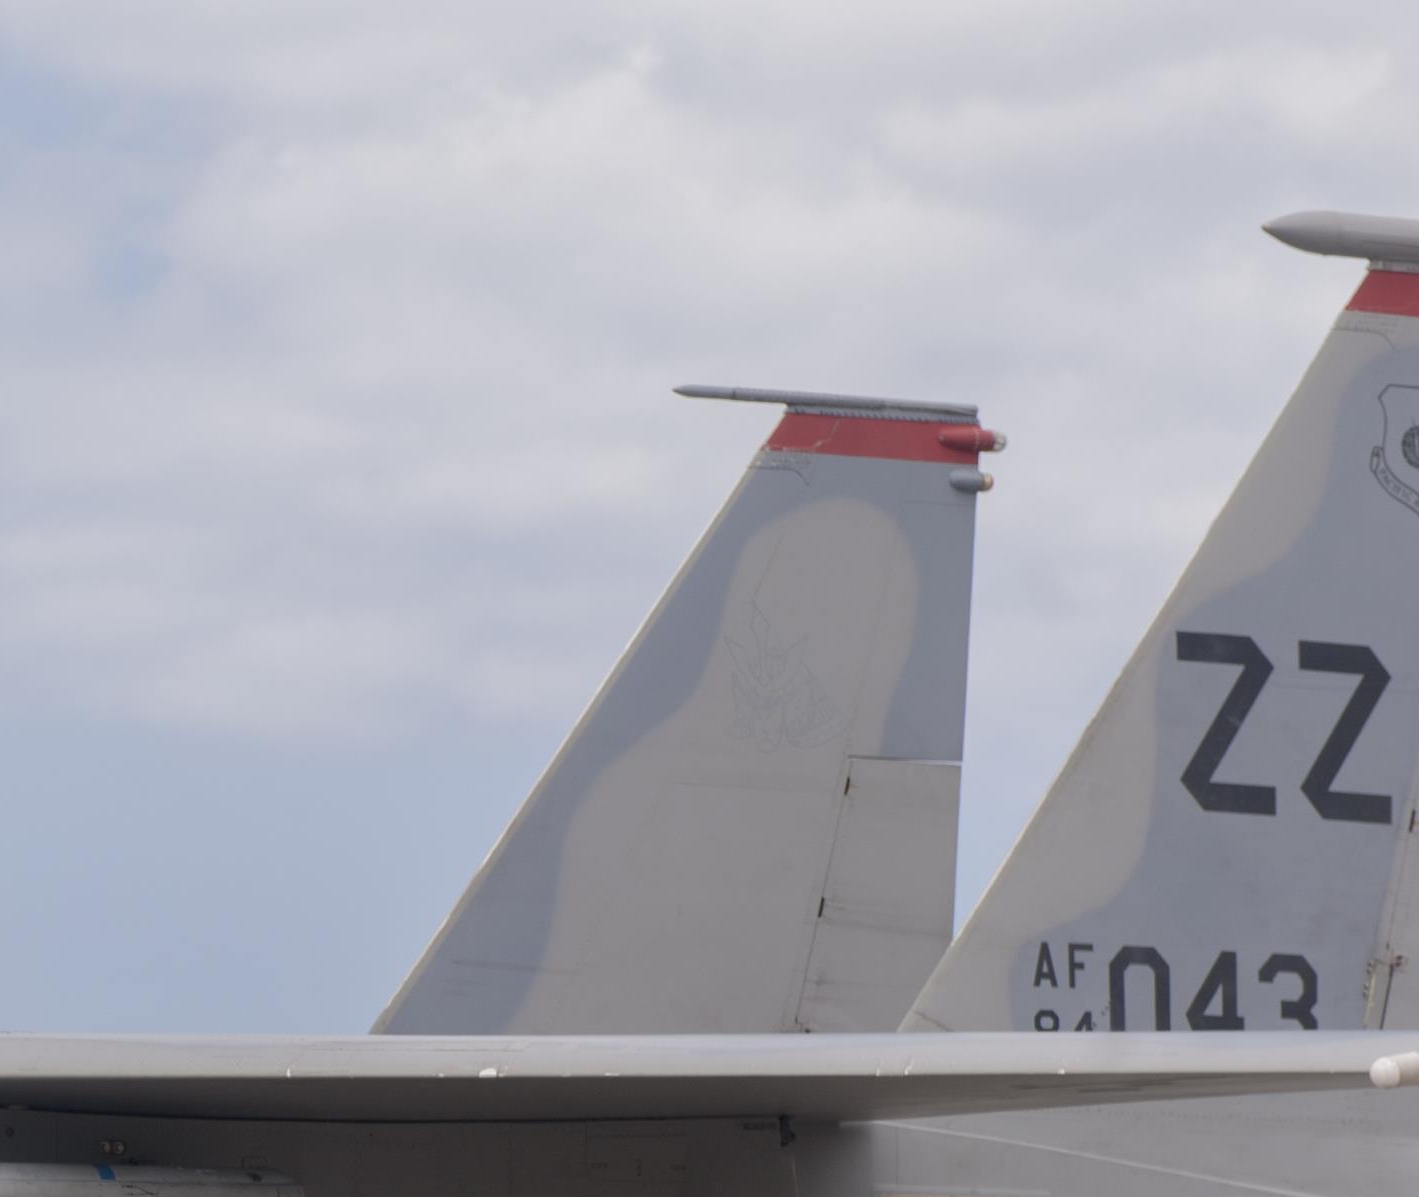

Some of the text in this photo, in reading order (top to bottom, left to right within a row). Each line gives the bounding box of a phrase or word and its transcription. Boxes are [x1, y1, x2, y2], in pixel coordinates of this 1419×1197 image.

[1175, 630, 1393, 825] ZZ
[1033, 941, 1319, 1032] AF 043
